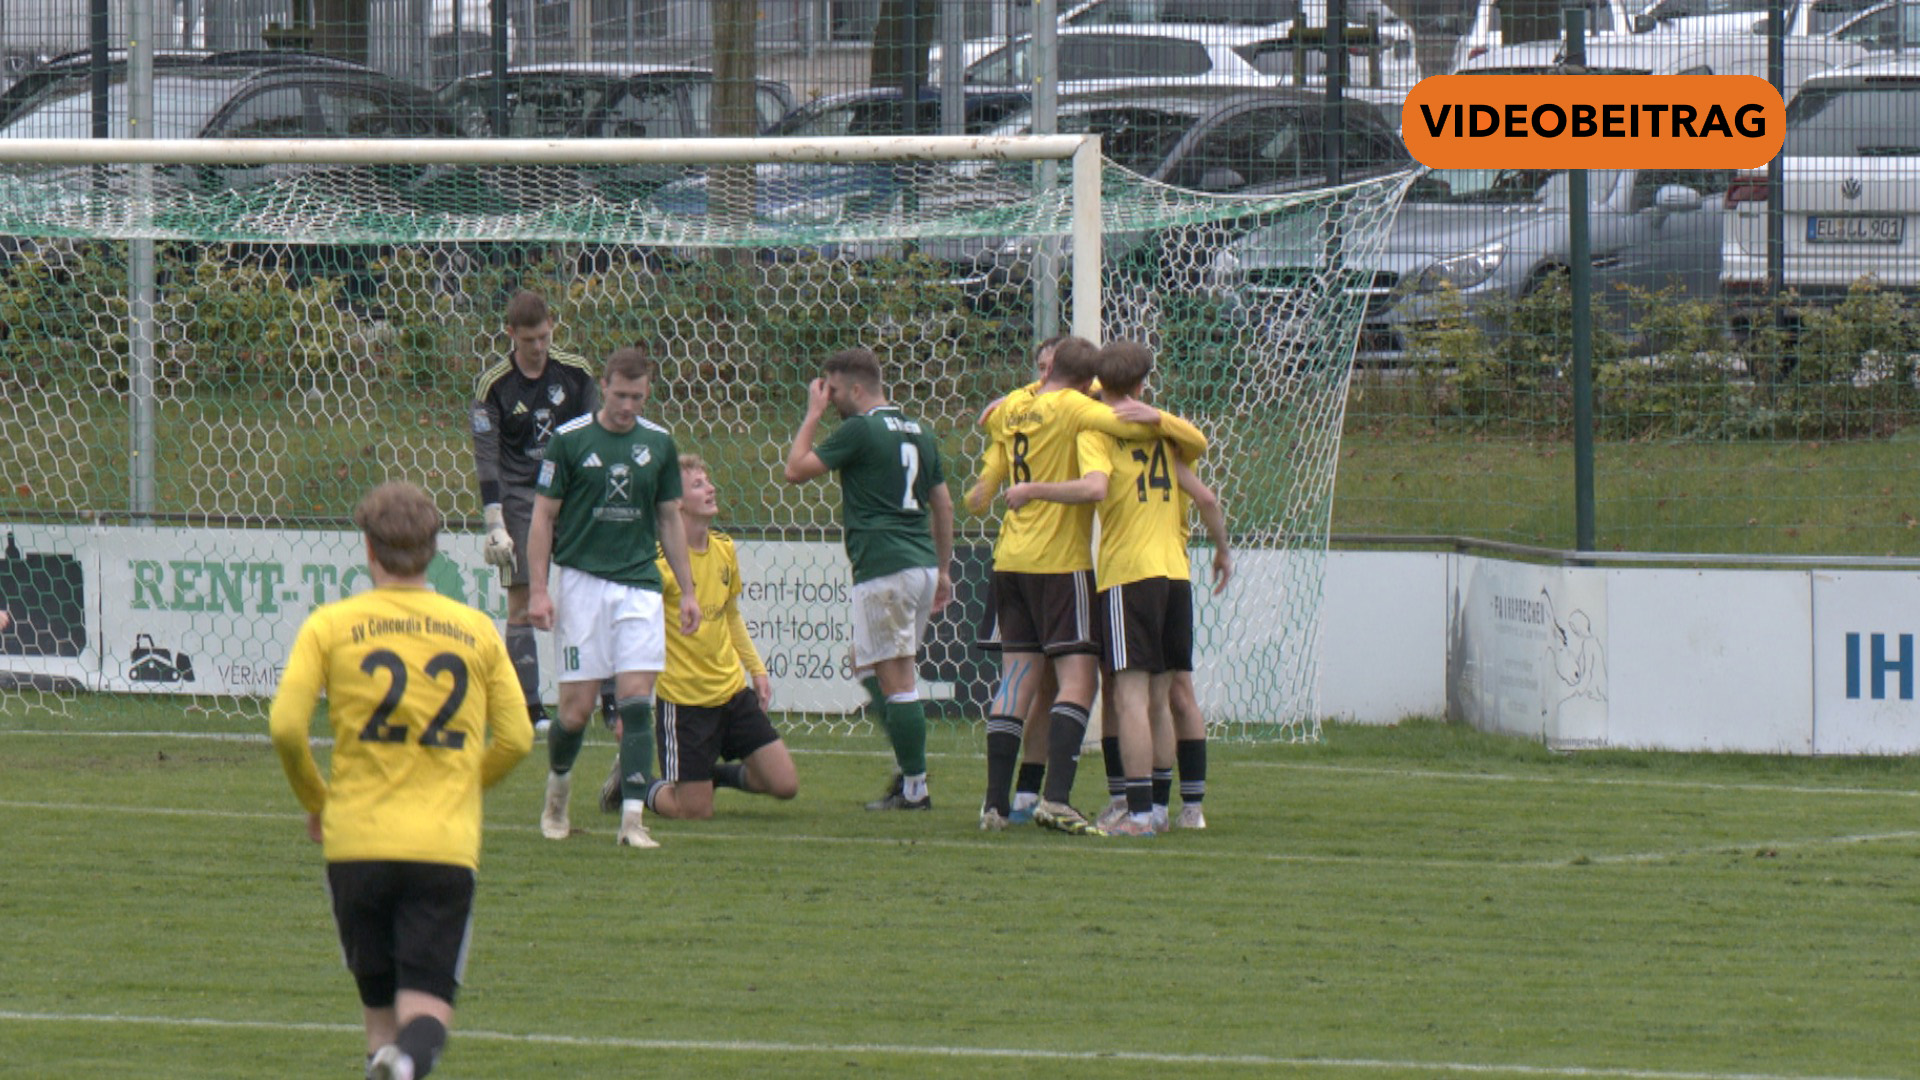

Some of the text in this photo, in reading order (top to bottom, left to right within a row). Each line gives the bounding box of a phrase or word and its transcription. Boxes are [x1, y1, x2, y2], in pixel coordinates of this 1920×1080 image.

[901, 442, 919, 510] 2
[1014, 432, 1031, 485] 8
[1131, 438, 1172, 502] 14
[368, 616, 421, 637] Concordia
[563, 646, 580, 671] 18
[795, 655, 834, 680] 526
[1846, 632, 1913, 699] IH
[359, 648, 469, 749] 22
